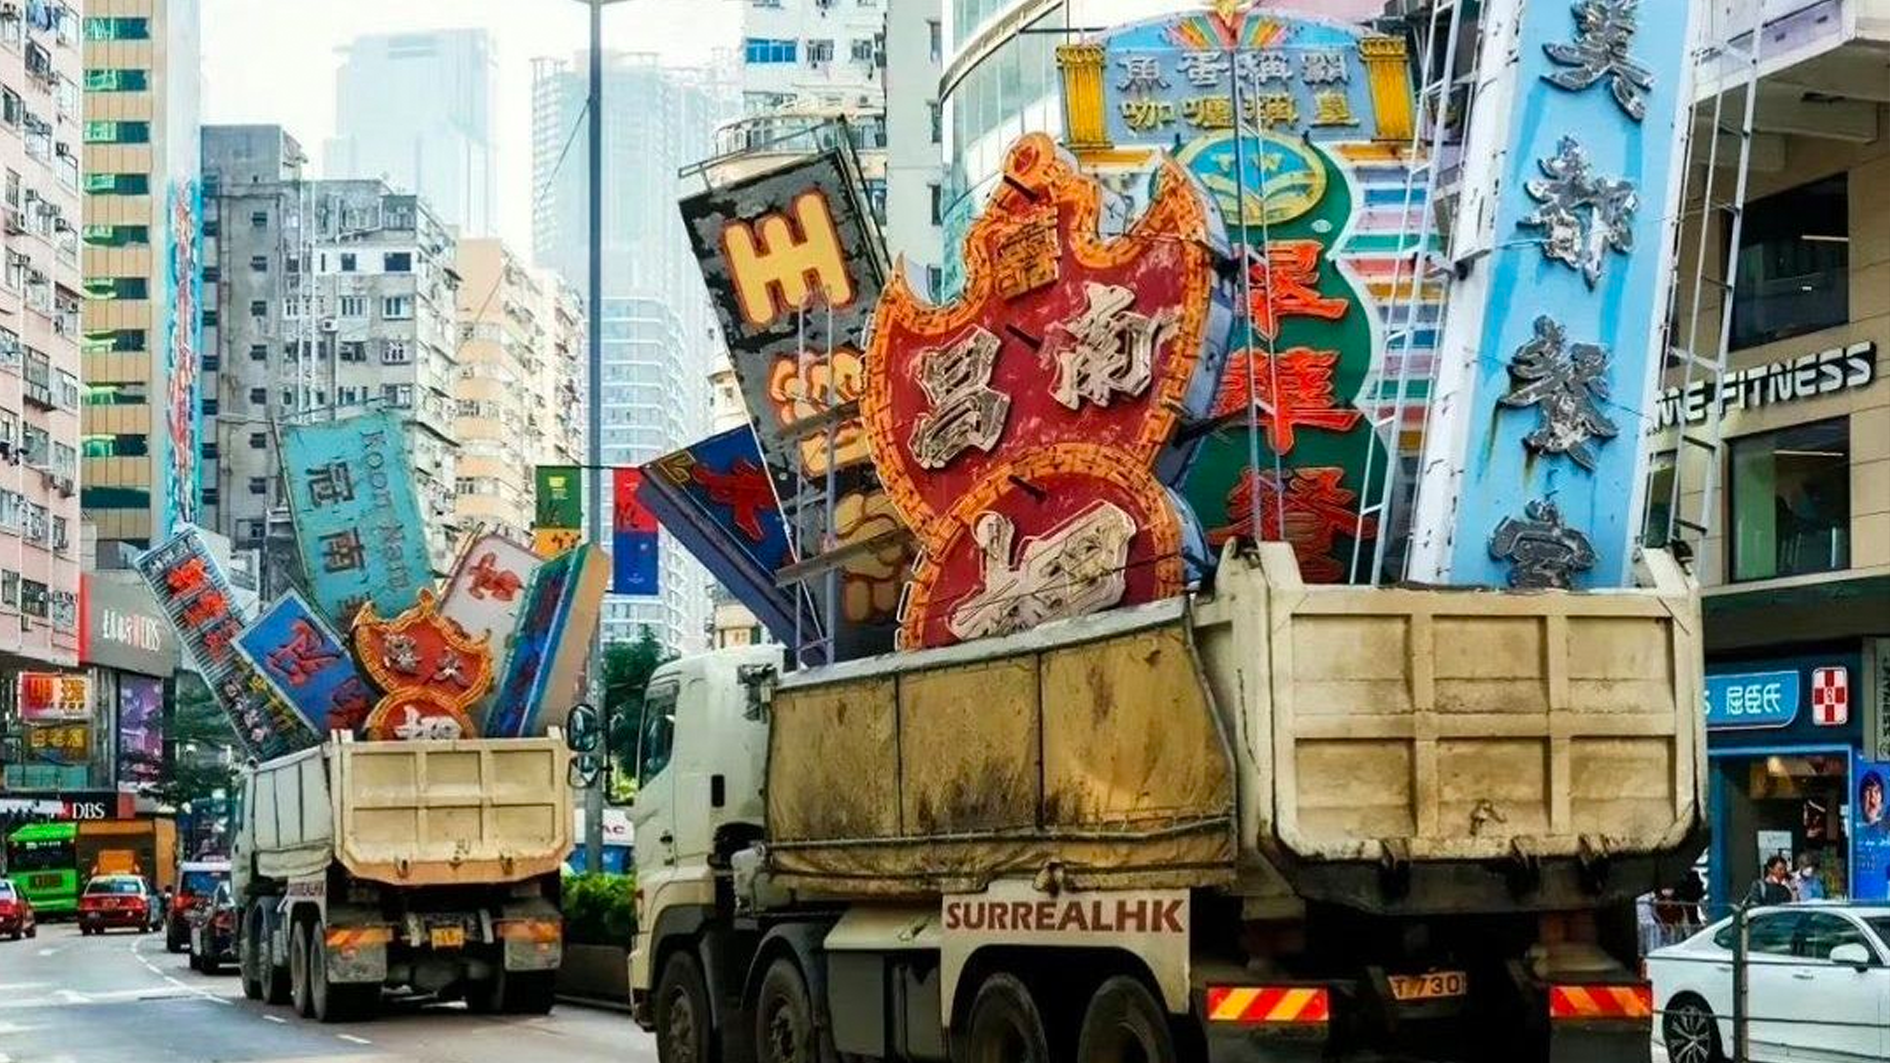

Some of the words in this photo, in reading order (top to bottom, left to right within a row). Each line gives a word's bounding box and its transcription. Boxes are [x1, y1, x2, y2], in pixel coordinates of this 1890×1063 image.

[1719, 341, 1871, 414] FITNESS
[1726, 683, 1781, 715] 屈臣氏
[72, 802, 106, 819] DBS
[945, 899, 1185, 934] SURREALHK
